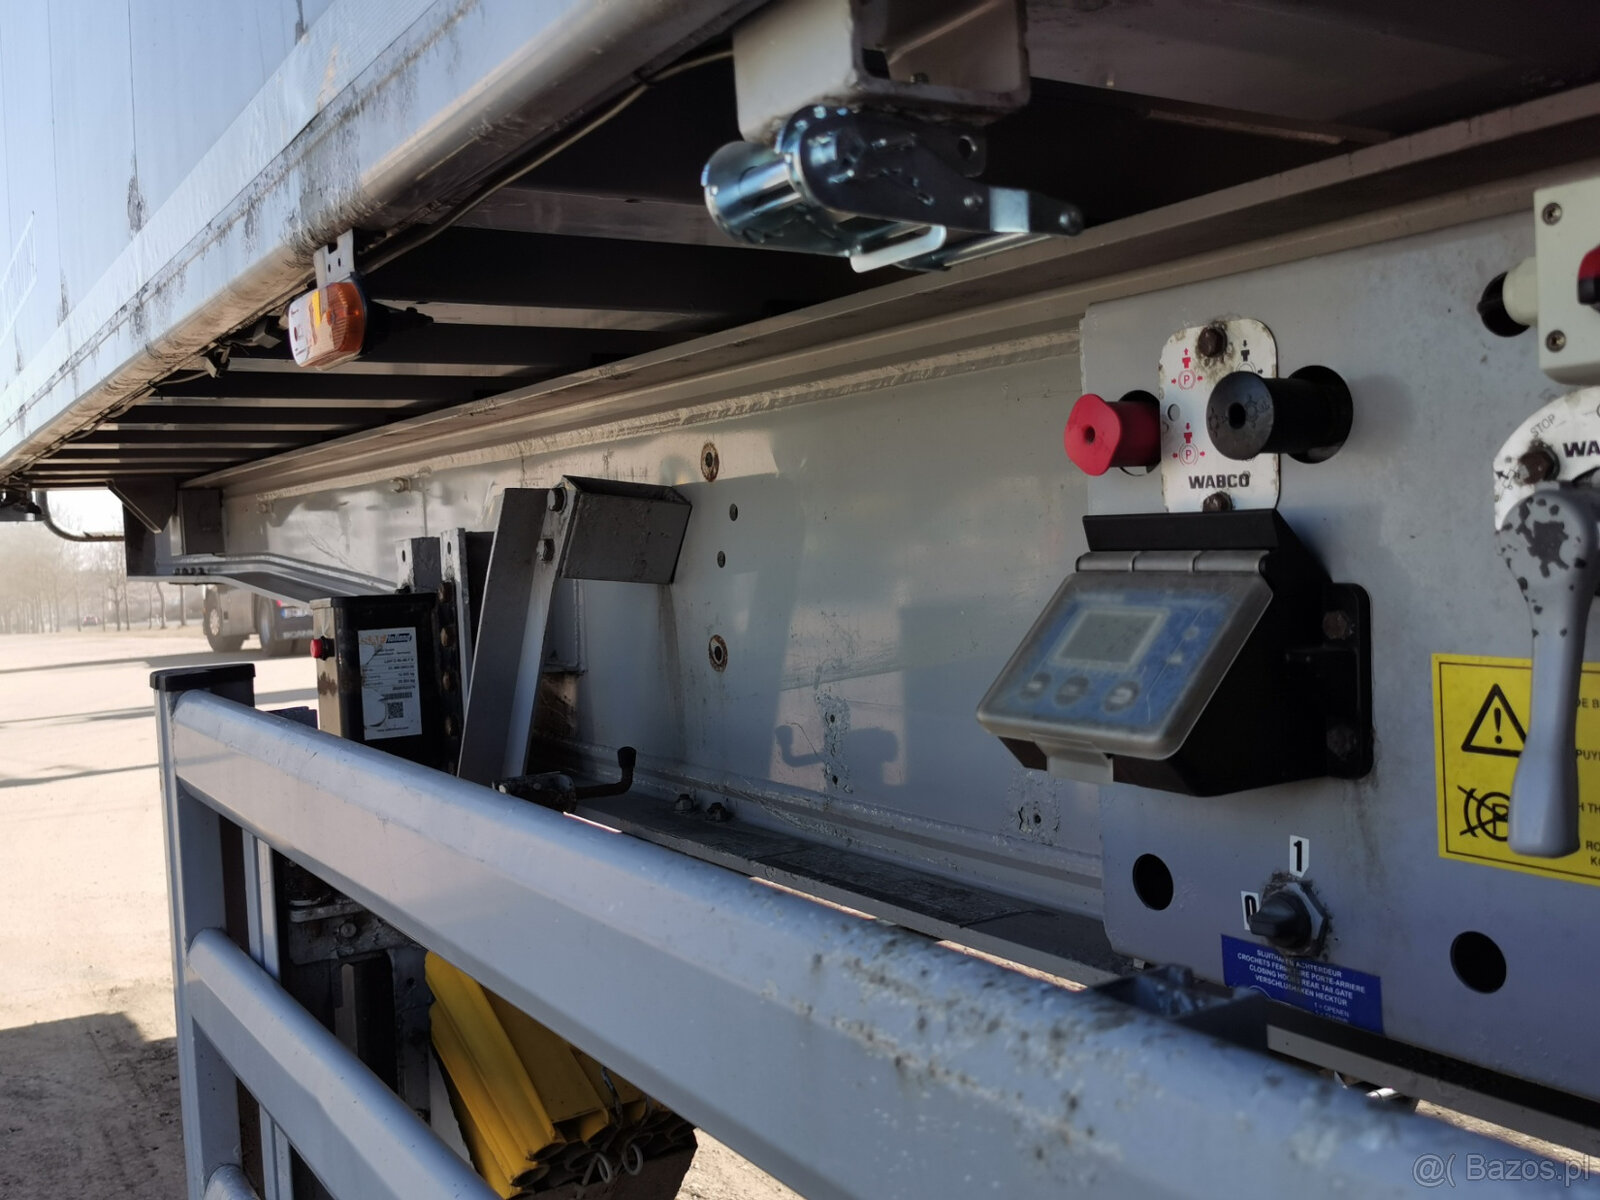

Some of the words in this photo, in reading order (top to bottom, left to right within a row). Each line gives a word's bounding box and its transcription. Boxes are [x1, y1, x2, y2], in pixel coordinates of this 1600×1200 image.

[1530, 413, 1556, 438] STOP
[1188, 472, 1250, 490] WABCO
[1293, 840, 1303, 873] 1
[1237, 952, 1271, 967] CROCHETS
[1249, 964, 1277, 978] CLOSING
[1334, 988, 1353, 1000] GATE
